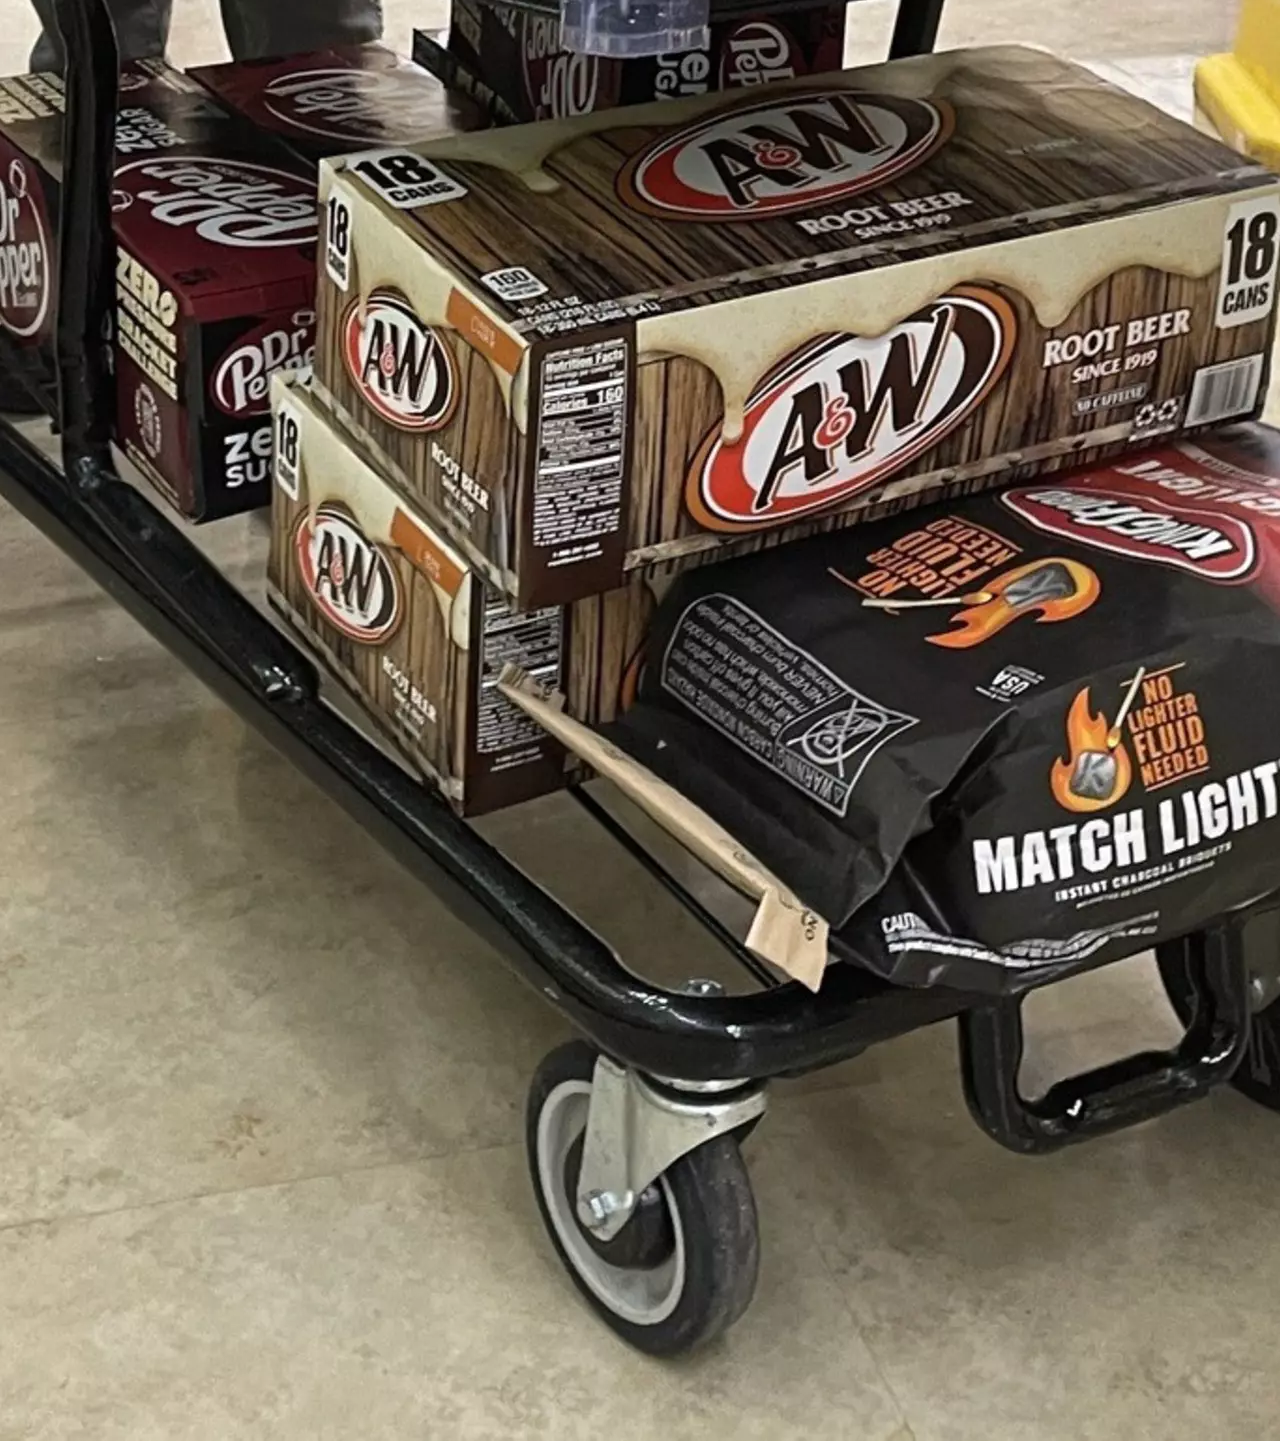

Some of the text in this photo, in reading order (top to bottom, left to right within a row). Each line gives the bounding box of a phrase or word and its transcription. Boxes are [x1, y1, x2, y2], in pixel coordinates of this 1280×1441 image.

[693, 89, 894, 210] A&W
[353, 153, 441, 194] 18
[387, 180, 457, 203] CANS
[327, 195, 350, 248] 18
[800, 190, 972, 238] ROOT BEER
[853, 211, 952, 241] SINCE 1919
[1224, 209, 1276, 284] 18
[487, 268, 531, 287] 160
[1222, 282, 1270, 316] CANS
[262, 327, 309, 372] Dr
[360, 318, 434, 404] A&W
[596, 348, 624, 364] Facts
[1042, 309, 1191, 368] ROOT BEER
[1071, 349, 1158, 384] SINCE 1919
[543, 387, 624, 412] Calories 160
[755, 306, 957, 513] A&W
[224, 426, 273, 465] ze
[279, 411, 298, 468] 18
[431, 441, 491, 511] ROOT BEER
[894, 529, 992, 584] FLUID
[928, 518, 1016, 564] NEEDED
[317, 532, 380, 616] A&W
[858, 571, 903, 596] NO
[866, 549, 958, 600] LIGHTER
[382, 655, 438, 724] ROOT BEER
[781, 665, 829, 705] NEVER
[994, 669, 1029, 699] USA
[1143, 675, 1173, 704] NO
[1128, 693, 1198, 734] LIGHTER
[1133, 715, 1206, 763] FLUID
[1140, 744, 1210, 788] NEEDED
[972, 807, 1146, 895] MATCH
[1158, 762, 1280, 853] LIGHT
[1055, 877, 1108, 903] INSTANT
[1112, 861, 1174, 890] CHARCOAL
